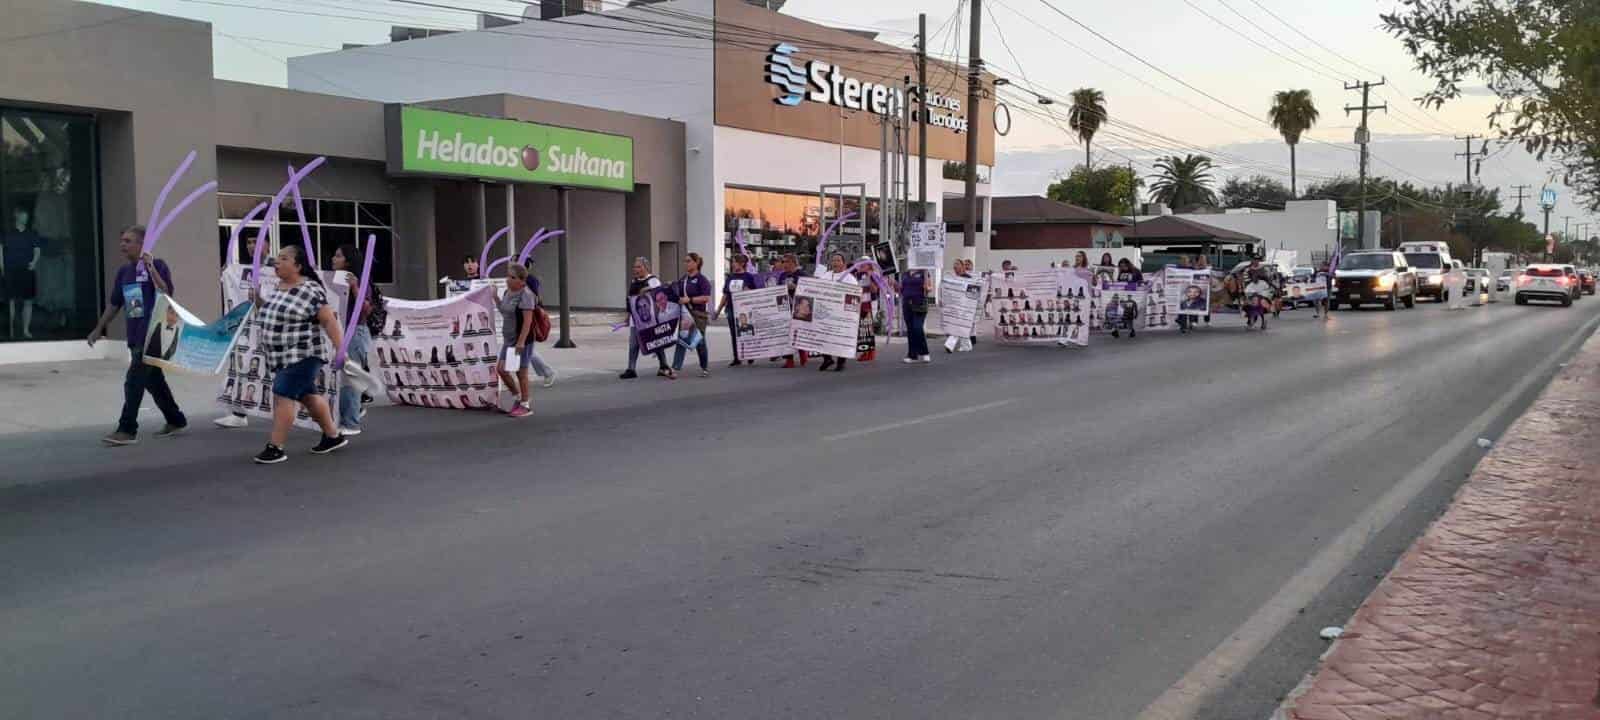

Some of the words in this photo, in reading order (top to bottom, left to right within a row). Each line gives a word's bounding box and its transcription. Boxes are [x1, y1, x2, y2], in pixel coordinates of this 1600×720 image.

[809, 59, 904, 120] Steren
[416, 129, 518, 168] Helados
[547, 145, 625, 179] Sultana
